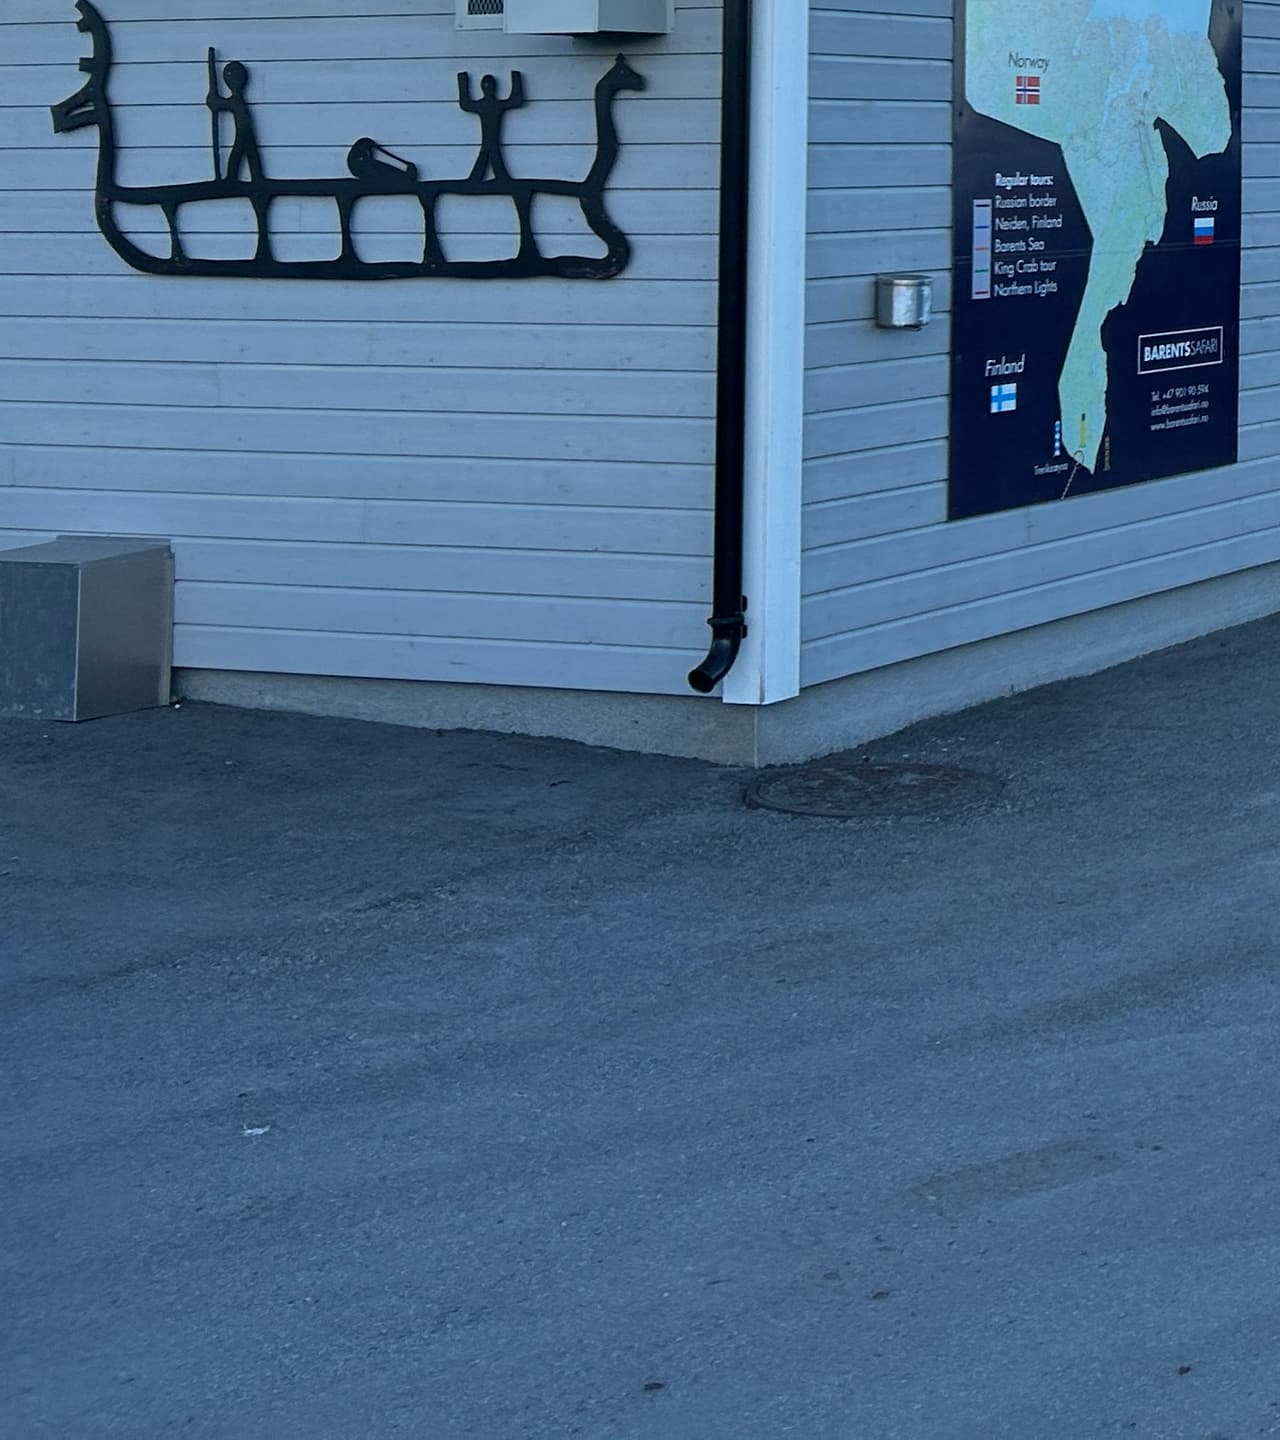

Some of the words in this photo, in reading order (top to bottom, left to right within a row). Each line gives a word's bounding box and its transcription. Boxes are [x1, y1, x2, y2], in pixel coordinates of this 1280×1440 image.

[1008, 51, 1050, 74] Norway
[995, 171, 1029, 190] Regular
[995, 194, 1027, 208] Russian
[1029, 193, 1057, 208] border
[1191, 195, 1219, 211] Russia
[995, 215, 1030, 231] Neiden,
[1032, 213, 1063, 229] Finland
[994, 238, 1027, 253] Barents
[1028, 236, 1045, 251] Sea
[993, 261, 1015, 278] King
[1016, 258, 1039, 273] Crab
[1040, 260, 1057, 271] tour
[993, 283, 1033, 297] Northern
[1034, 278, 1058, 297] Lights
[985, 352, 1026, 377] Finland
